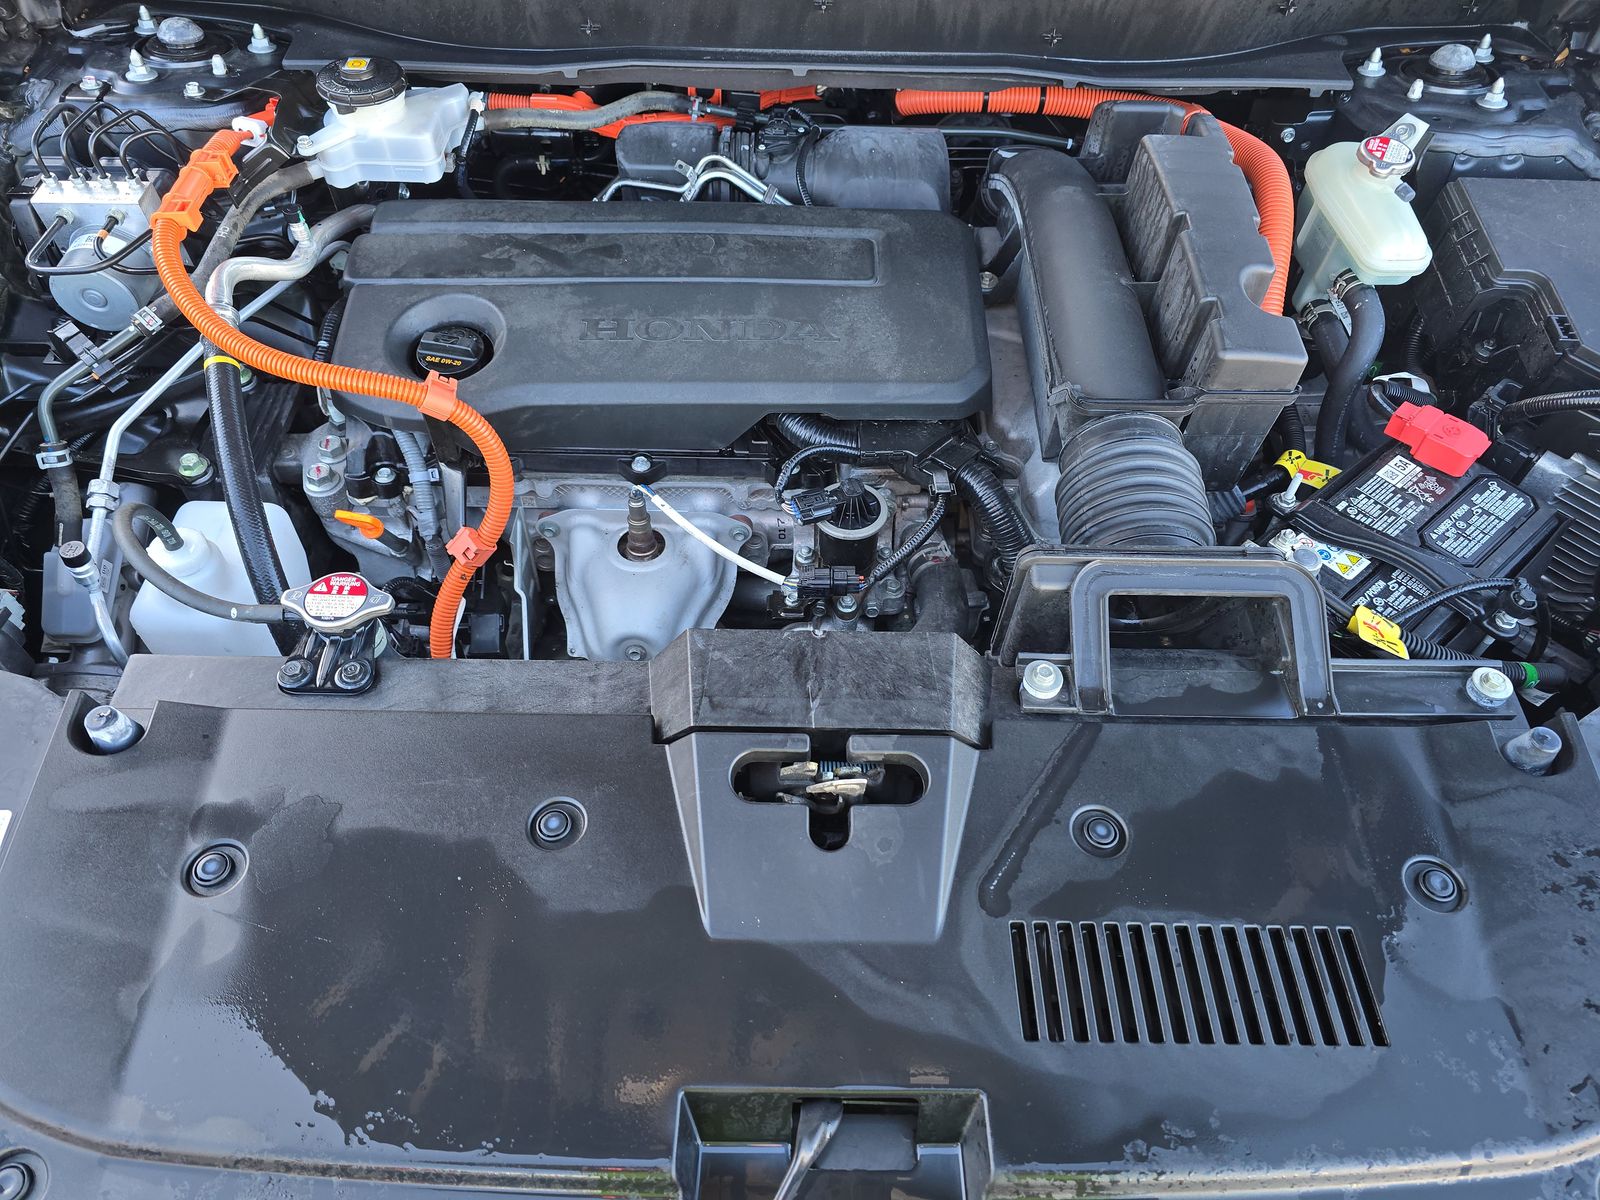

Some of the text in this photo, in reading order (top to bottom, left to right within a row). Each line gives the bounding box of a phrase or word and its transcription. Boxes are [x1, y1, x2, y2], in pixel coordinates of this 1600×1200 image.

[578, 317, 841, 343] HONDA
[425, 355, 462, 367] SAE 0W-20
[1394, 459, 1411, 472] 5A
